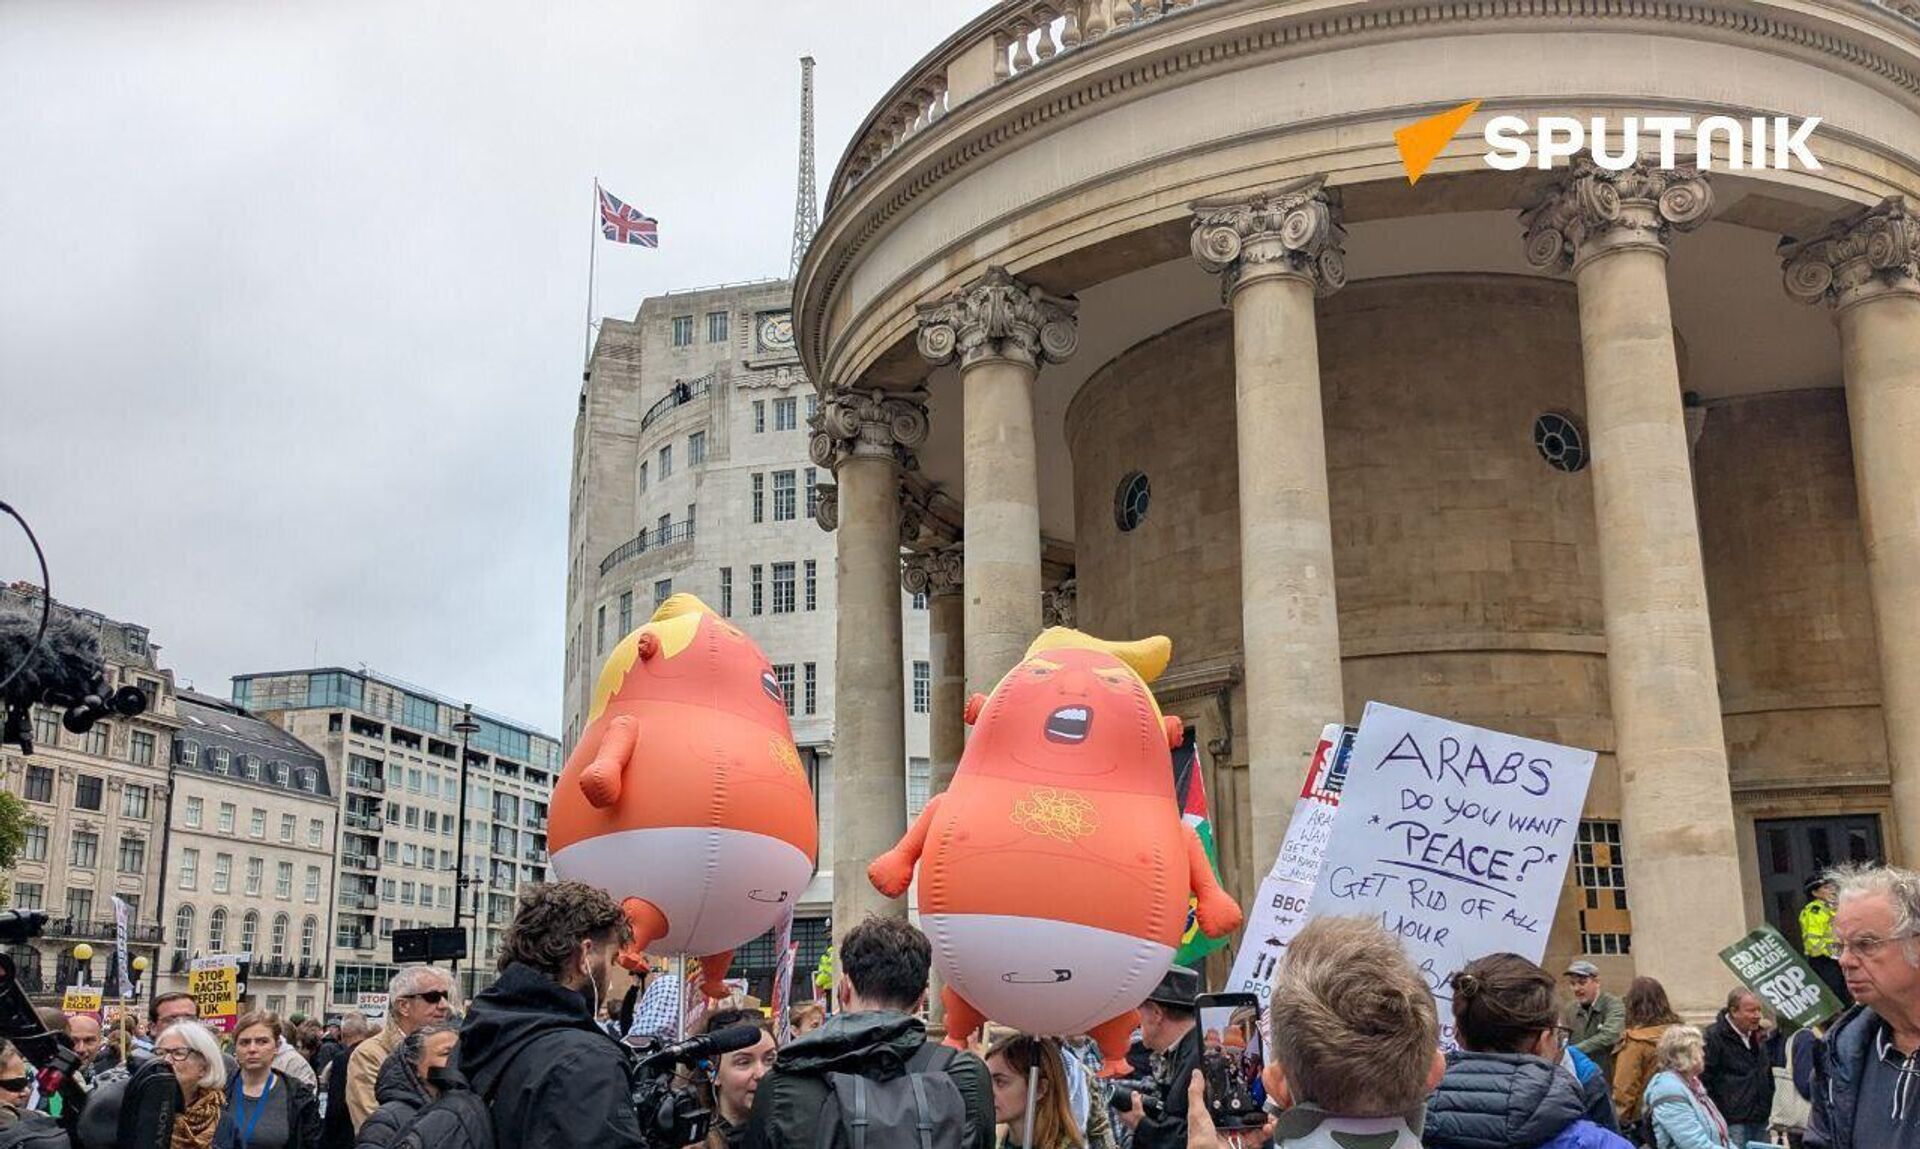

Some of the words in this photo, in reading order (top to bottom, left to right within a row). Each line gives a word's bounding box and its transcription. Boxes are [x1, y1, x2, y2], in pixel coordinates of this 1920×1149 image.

[1375, 732, 1553, 797] ARABS
[1401, 788, 1434, 811] DO
[1443, 797, 1502, 827] YOU
[1509, 812, 1568, 838] WANT
[1330, 866, 1399, 900] GET
[1408, 879, 1448, 911] RID
[1461, 898, 1496, 920] OF
[1502, 908, 1538, 933] ALL
[1382, 910, 1450, 948] YOUR
[193, 980, 230, 993] RACIST
[198, 969, 225, 982] STOP
[1759, 966, 1806, 1005] STOP
[204, 1004, 219, 1014] UK
[360, 994, 387, 1004] STOP
